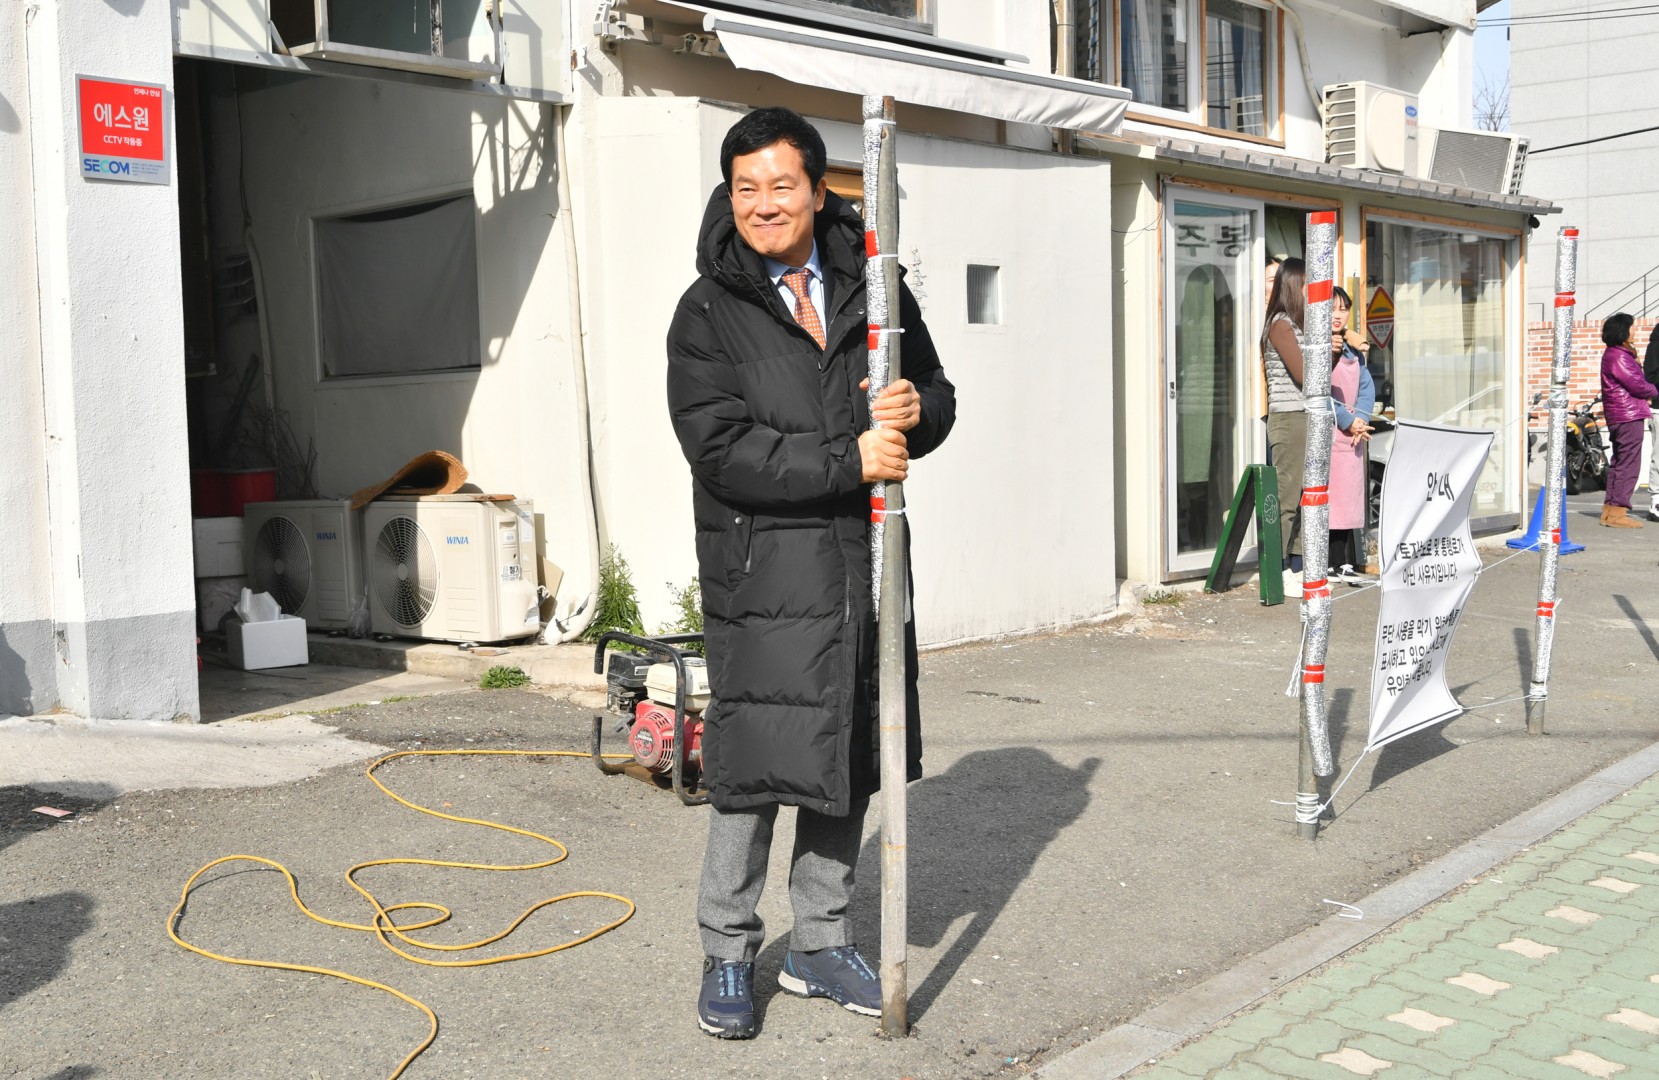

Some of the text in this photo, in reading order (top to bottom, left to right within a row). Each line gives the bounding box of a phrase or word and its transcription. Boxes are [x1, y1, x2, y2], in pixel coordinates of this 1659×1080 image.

[93, 103, 149, 131] 에스원
[103, 135, 142, 146] CCTV 작동중
[84, 158, 130, 175] SECOM
[1426, 471, 1455, 502] 안내
[316, 532, 337, 541] WINIA
[446, 536, 469, 545] WINIA
[1382, 624, 1394, 645] 무단
[1396, 620, 1414, 641] 사용을
[1417, 617, 1432, 637] 막기
[1381, 649, 1407, 671] 표시하고
